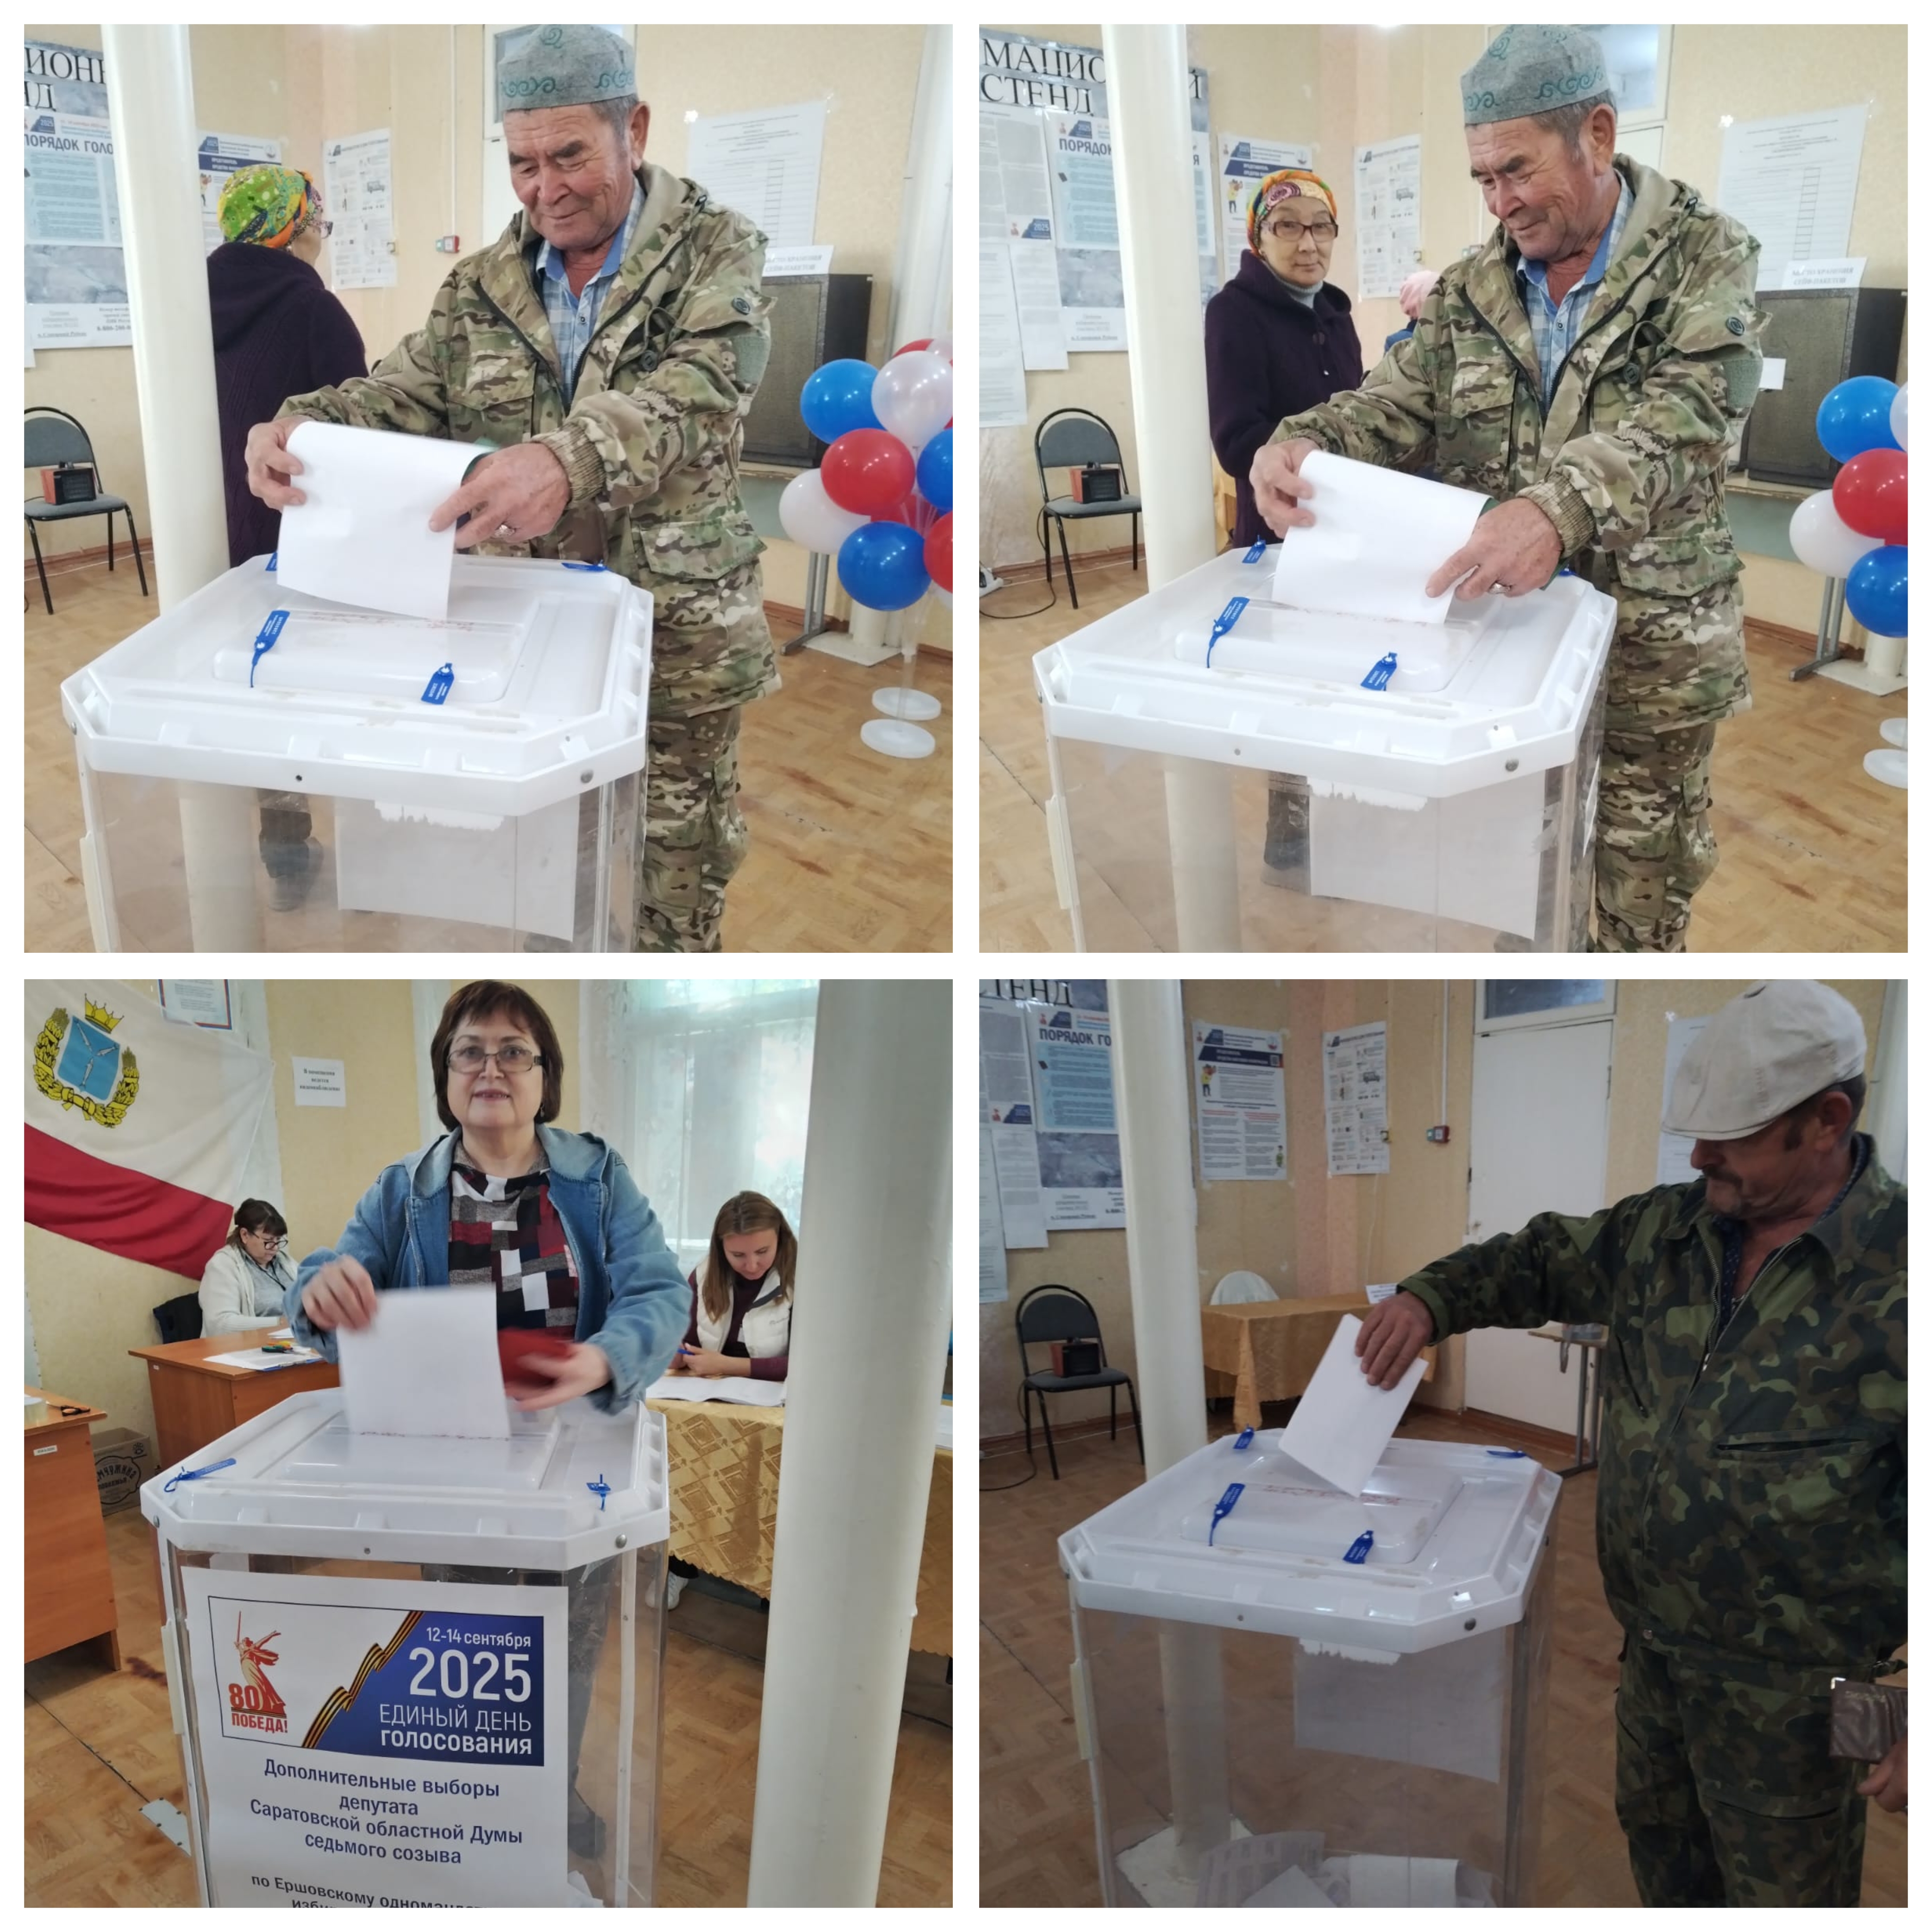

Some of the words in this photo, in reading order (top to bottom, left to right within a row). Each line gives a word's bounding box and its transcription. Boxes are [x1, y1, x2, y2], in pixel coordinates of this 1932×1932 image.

[981, 74, 1094, 117] СТЕНД
[24, 134, 79, 151] ПОРЯДОК
[1040, 1028, 1093, 1045] ПОРЯДОК
[427, 1627, 461, 1643] 12-14
[464, 1632, 531, 1649] сентября
[409, 1647, 532, 1702] 2025
[228, 1683, 260, 1710] 80
[232, 1713, 288, 1733] ПОБЕДА!
[380, 1704, 467, 1728] ЕДИНЫЙ
[475, 1710, 532, 1732] ДЕНЬ
[381, 1730, 532, 1754] голосования
[265, 1758, 416, 1791] Дополнительные
[423, 1779, 499, 1799] выборы
[339, 1796, 418, 1815] депутата
[250, 1799, 360, 1832] Саратовской
[366, 1821, 464, 1840] областной
[470, 1826, 522, 1845] Думы
[305, 1834, 386, 1857] седьмого
[393, 1848, 461, 1864] созыва
[251, 1876, 269, 1887] по
[275, 1877, 374, 1907] Ершовскому
